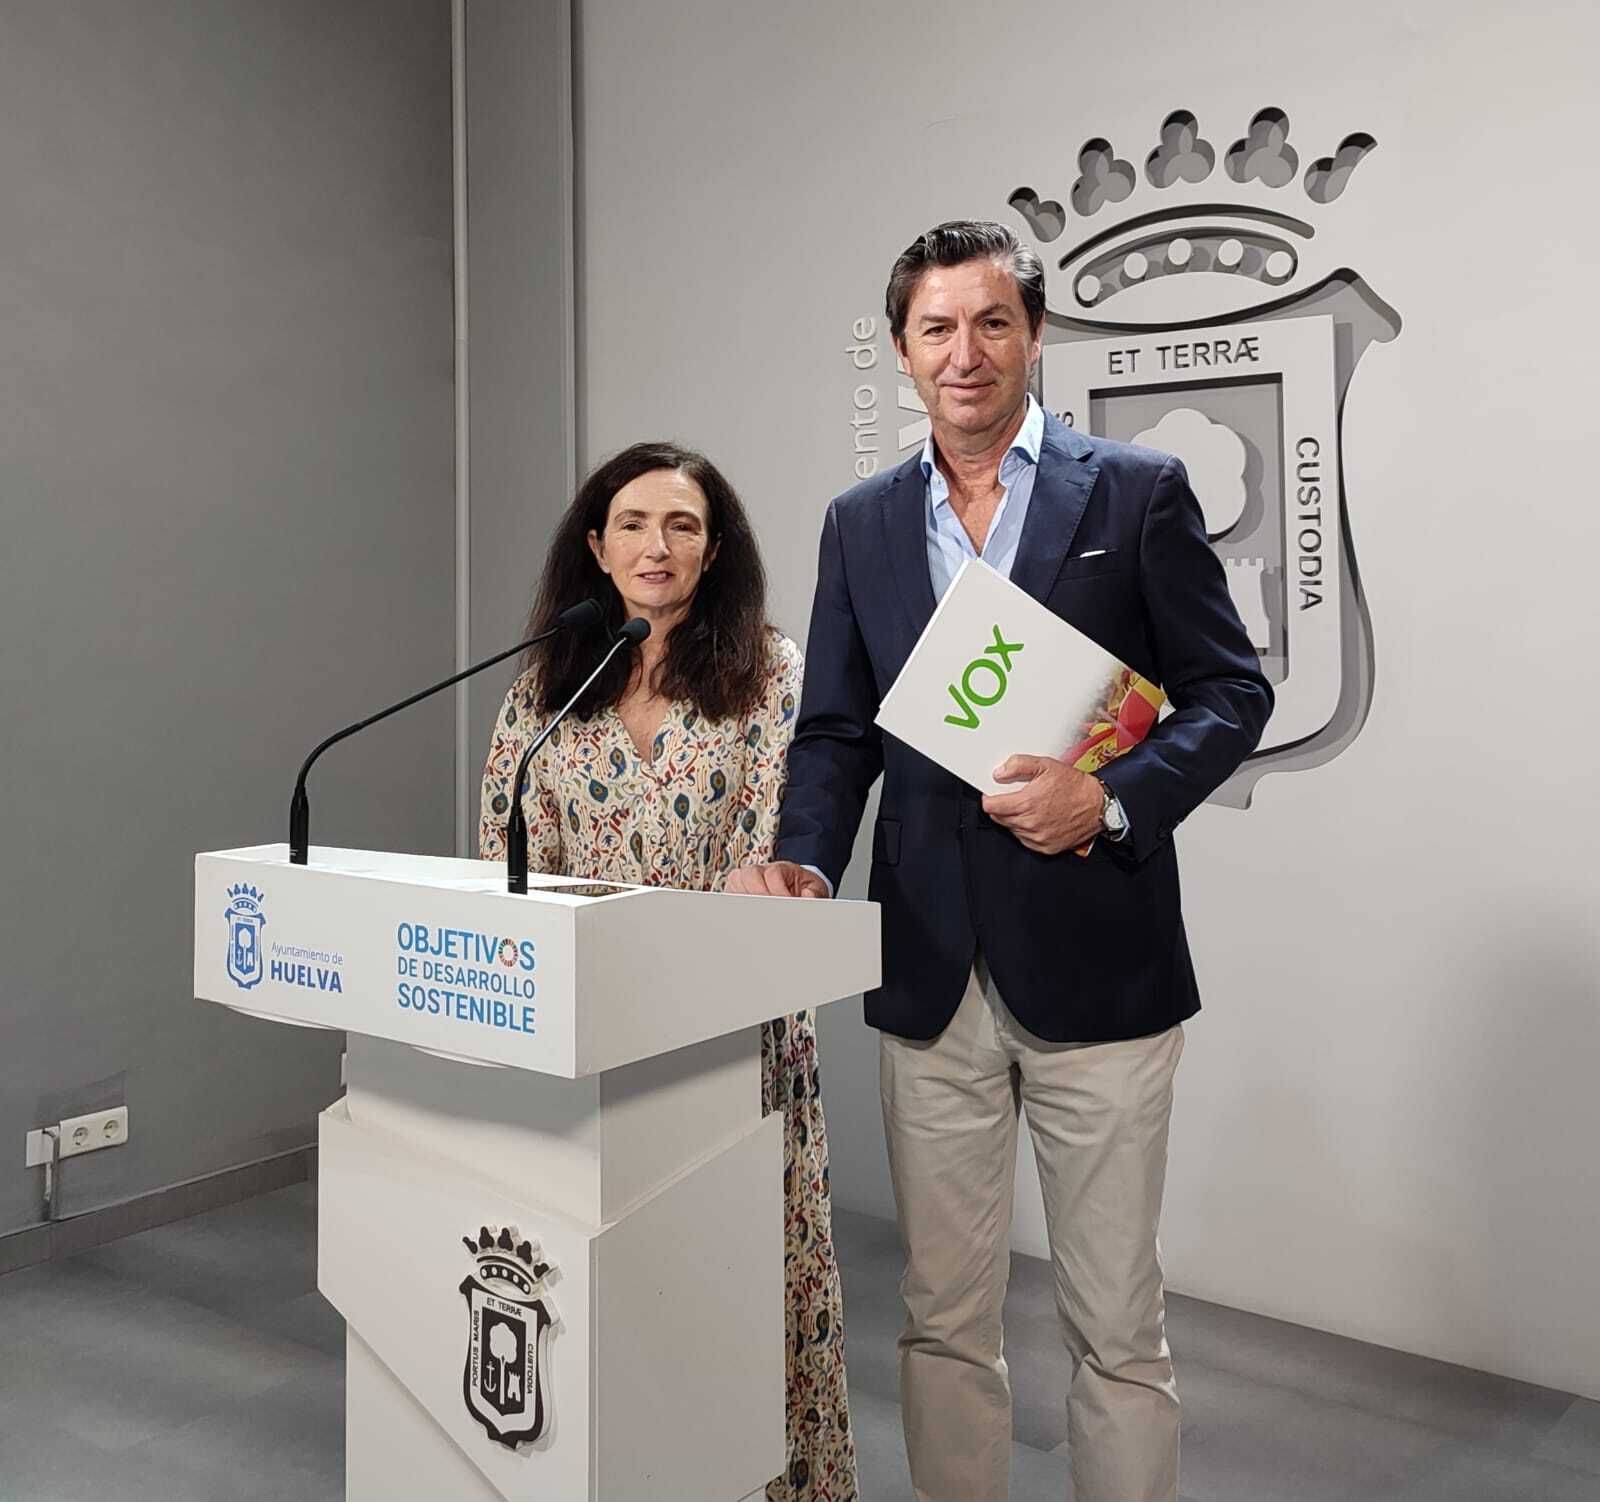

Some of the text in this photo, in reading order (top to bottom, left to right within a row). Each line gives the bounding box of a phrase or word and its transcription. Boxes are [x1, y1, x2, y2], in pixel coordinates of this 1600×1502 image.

[844, 316, 878, 370] de
[1108, 336, 1260, 376] ET TERRÆ
[1295, 436, 1324, 612] CUSTODIA
[943, 623, 1025, 730] VOX
[271, 941, 330, 963] Ayuntamiento
[331, 952, 344, 966] de
[397, 921, 536, 972] OBJETIVOS
[270, 959, 343, 994] HUELVA
[397, 956, 535, 1000] DE DESARROLLO
[397, 982, 536, 1035] SOSTENIBLE
[486, 1297, 495, 1307] ET
[472, 1346, 480, 1387] PORTUS
